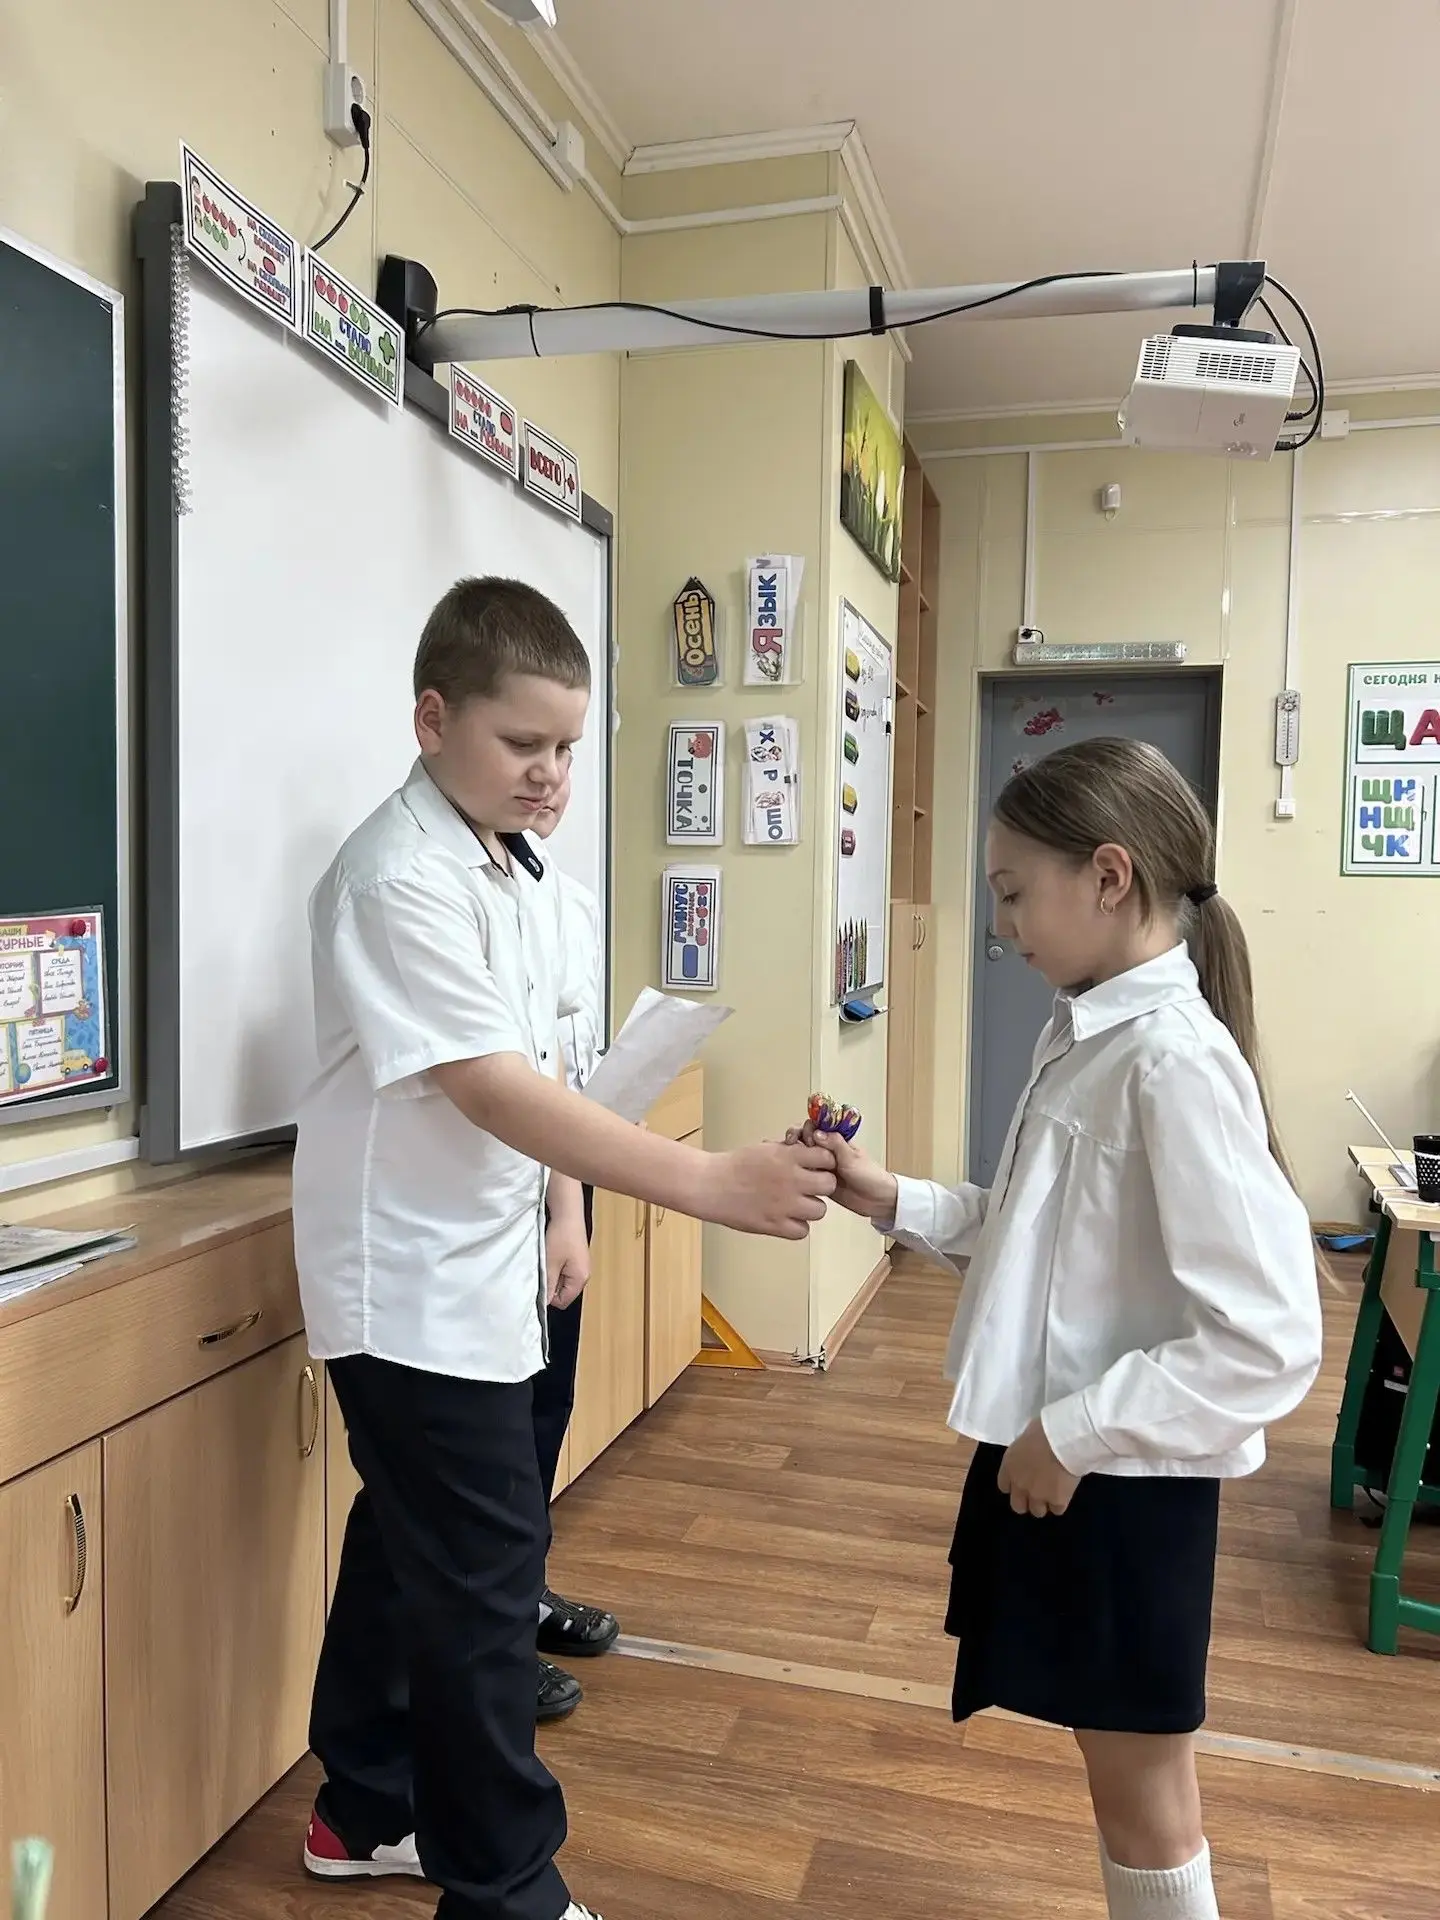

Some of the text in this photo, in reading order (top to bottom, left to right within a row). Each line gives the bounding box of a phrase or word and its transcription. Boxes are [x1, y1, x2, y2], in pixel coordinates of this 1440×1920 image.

[314, 311, 333, 342] НА
[339, 316, 372, 356] СТАЛО
[347, 340, 395, 391] БОЛЬШЕ
[456, 410, 469, 432] НА
[473, 410, 496, 437] СТАЛО
[530, 446, 562, 487] ВСЕГО
[1363, 674, 1427, 686] СЕГОДНЯ
[676, 757, 693, 830] ТОЧКА
[1360, 806, 1415, 831] НЩ
[1361, 834, 1410, 857] ЧК
[674, 883, 688, 944] МИНУС
[0, 961, 25, 970] ТОРНИК
